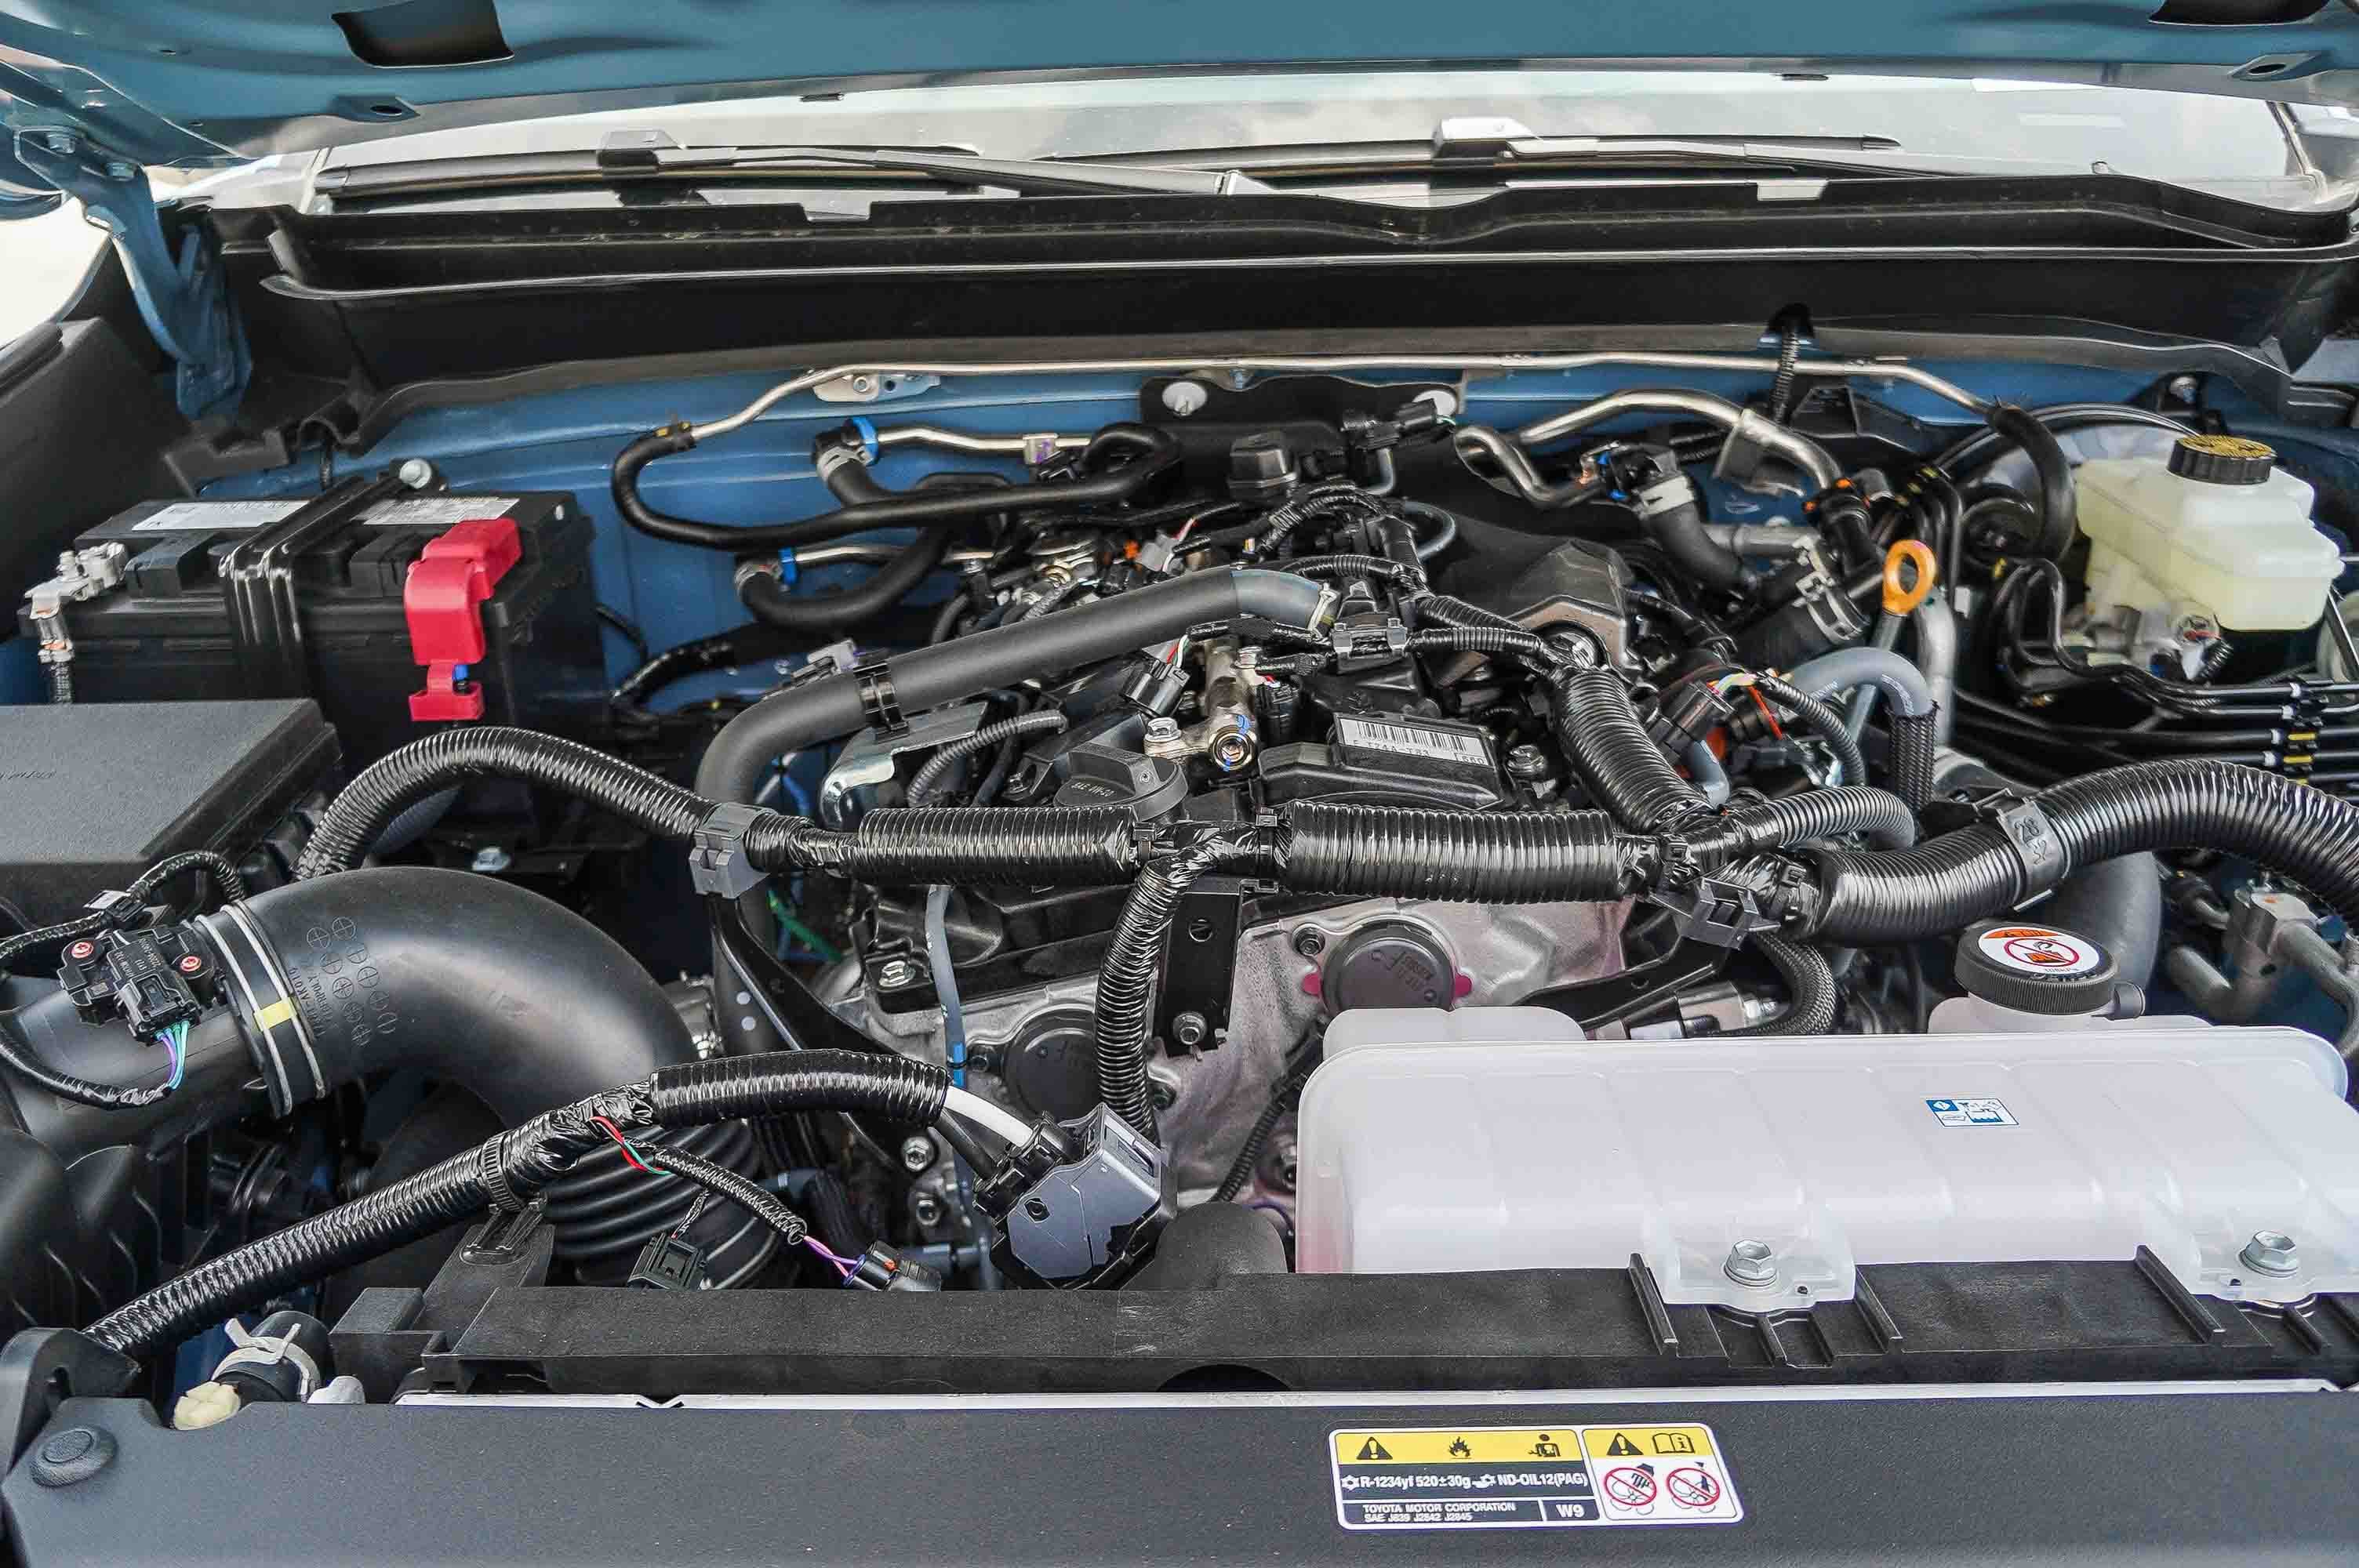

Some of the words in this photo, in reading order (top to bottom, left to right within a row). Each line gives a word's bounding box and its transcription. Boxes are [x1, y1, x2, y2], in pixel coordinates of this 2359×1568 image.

[1360, 1475, 1414, 1490] R-1234yf
[1416, 1475, 1472, 1489] 520±30g
[1497, 1472, 1588, 1487] ND-OIL12(PAG)
[1363, 1504, 1404, 1514] TOYOTA
[1405, 1503, 1443, 1513] MOTOR
[1445, 1502, 1517, 1512] CORPORATION
[1555, 1504, 1585, 1519] W9
[1364, 1513, 1387, 1523] SAE
